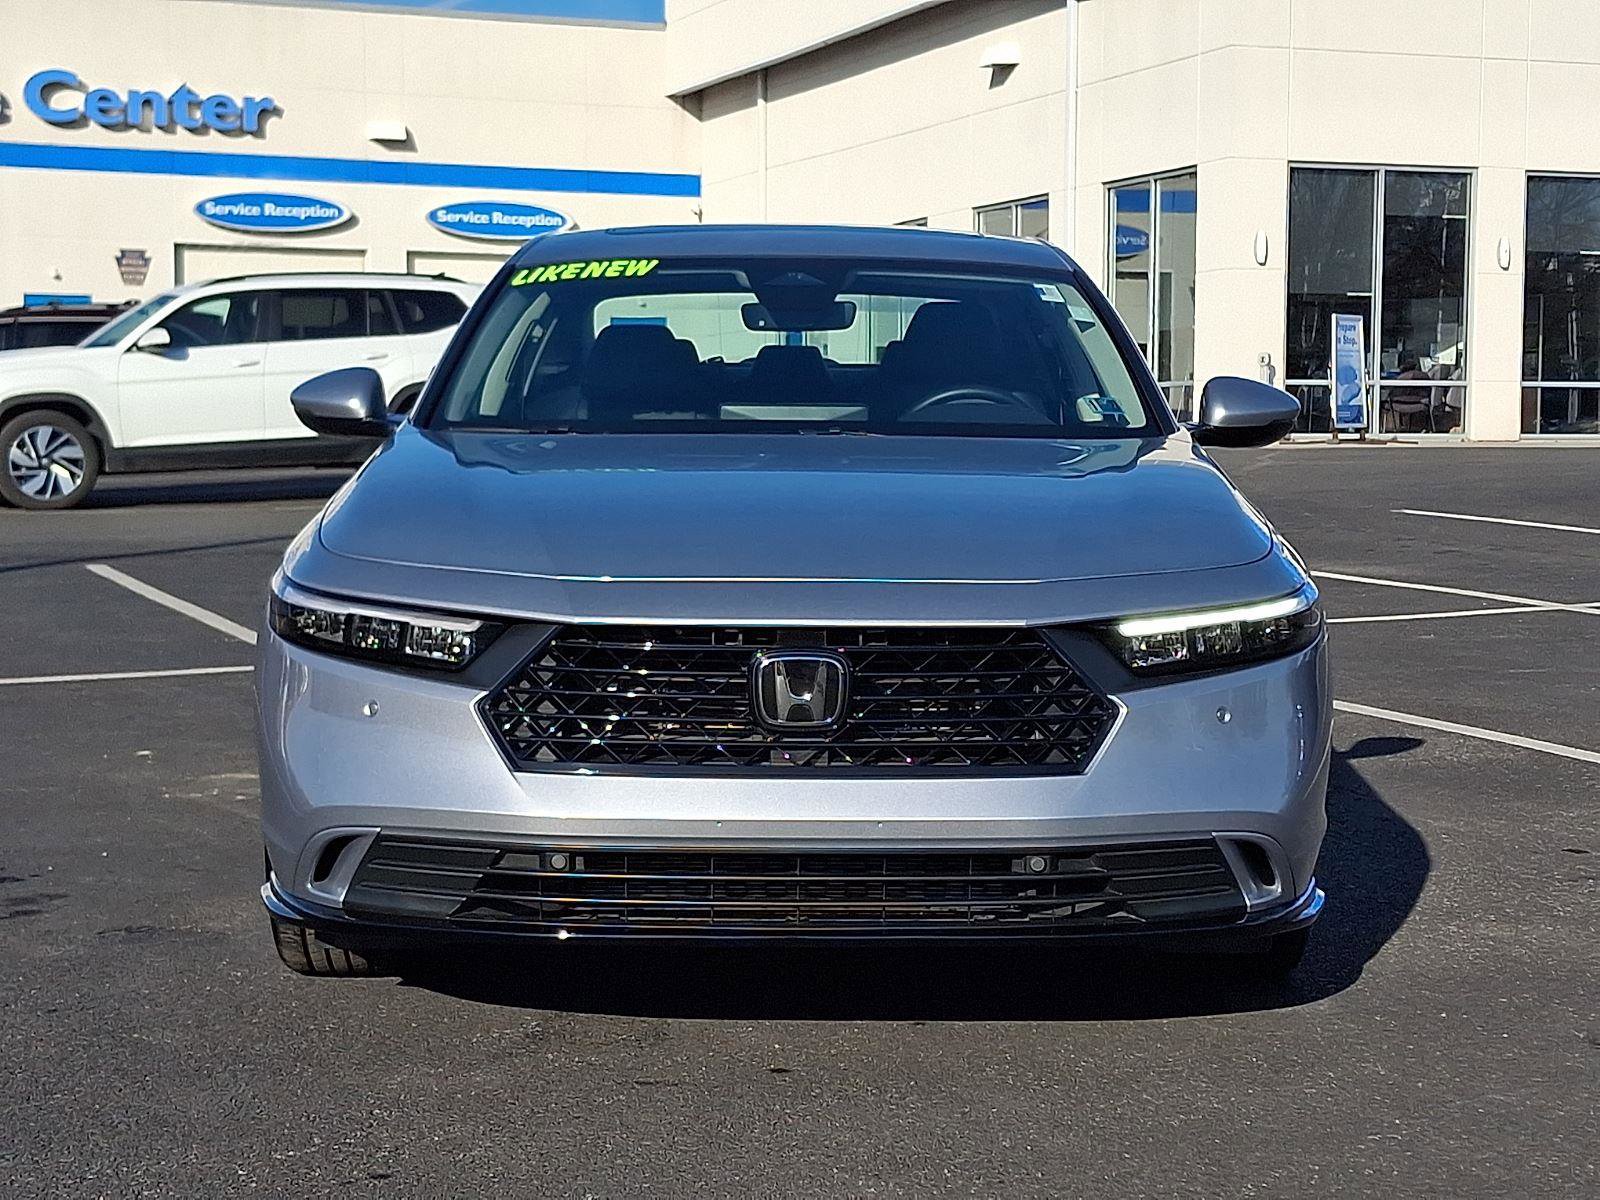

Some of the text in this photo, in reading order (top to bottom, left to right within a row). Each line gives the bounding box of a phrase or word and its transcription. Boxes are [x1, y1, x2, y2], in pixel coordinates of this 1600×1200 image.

[23, 69, 276, 134] Center
[204, 201, 339, 220] Service Reception
[436, 209, 563, 229] Service Reception
[511, 259, 660, 287] LIKENEW
